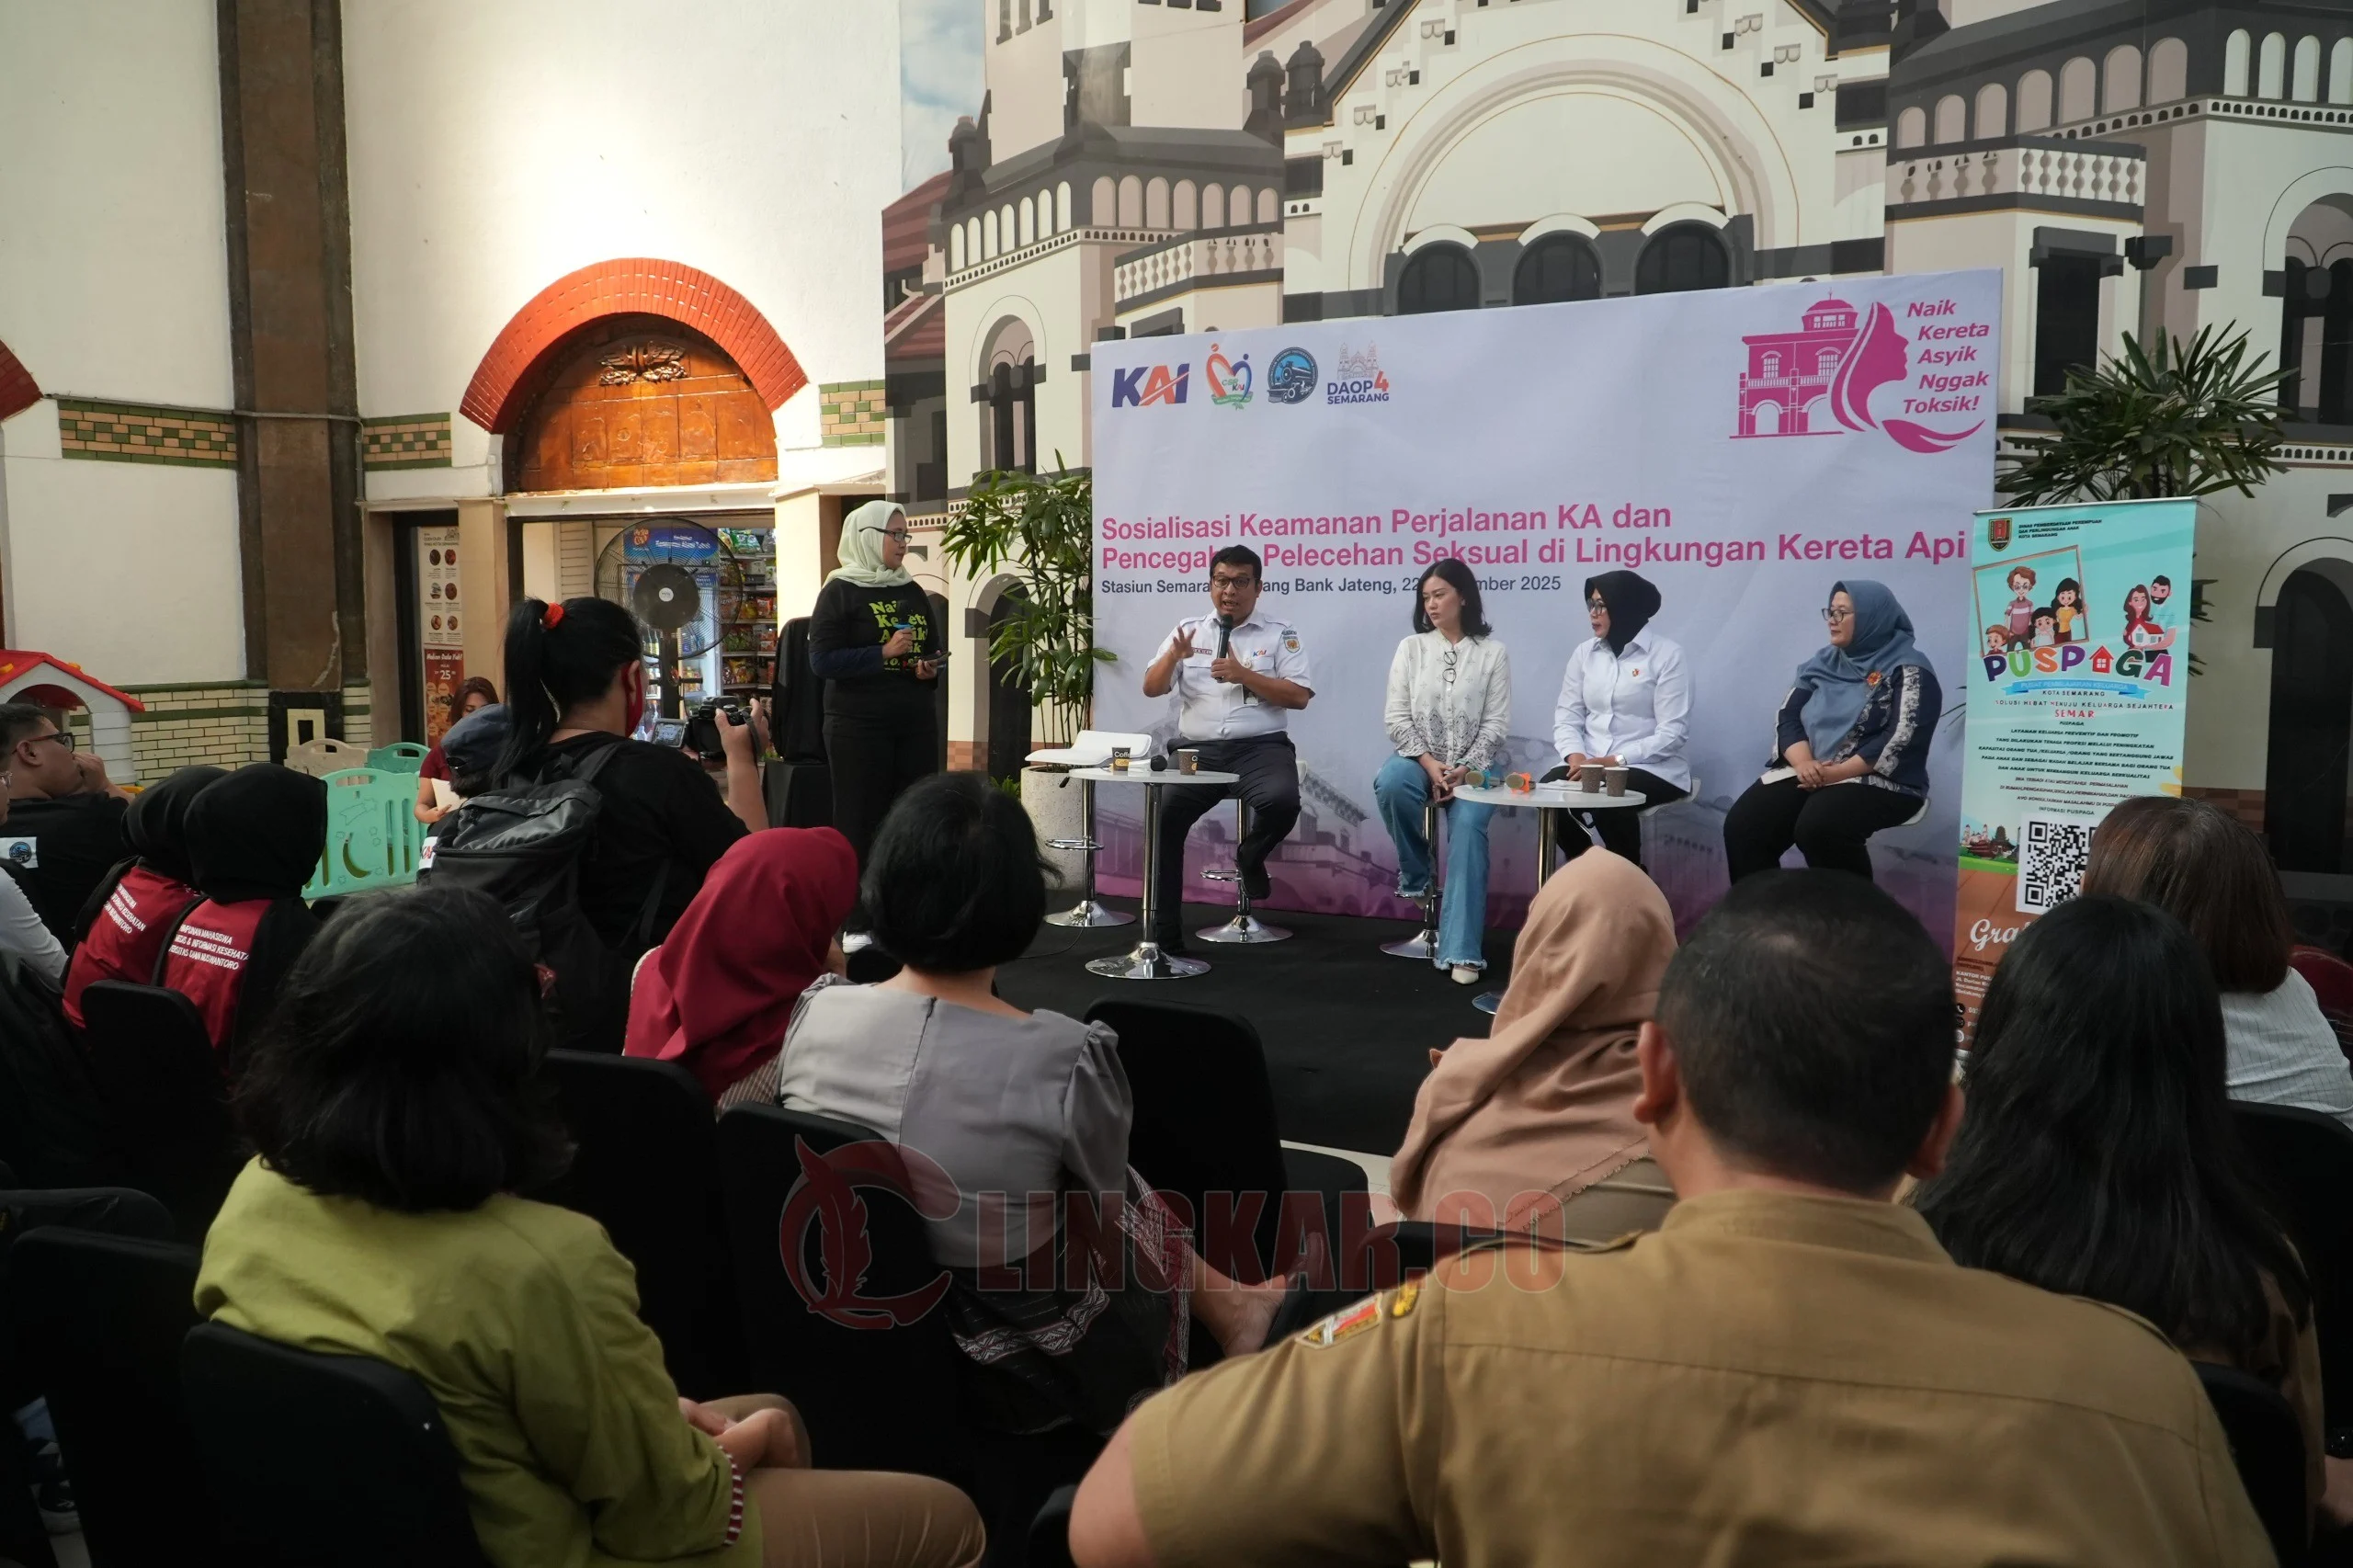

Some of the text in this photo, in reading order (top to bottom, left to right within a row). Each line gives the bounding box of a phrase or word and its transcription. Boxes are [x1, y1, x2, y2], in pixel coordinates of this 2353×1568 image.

[1907, 299, 1957, 318] Naik
[1917, 323, 1990, 341] Kereta
[1917, 346, 1977, 366] Asyik
[1111, 363, 1190, 408] KAI
[1327, 380, 1372, 396] DAOP
[1919, 370, 1989, 392] Nggak
[1327, 392, 1390, 405] SEMARANG
[1904, 395, 1980, 414] Toksik!
[1102, 503, 1671, 540] Sosialisasi Keamanan Perjalanan KA dan
[1264, 542, 1404, 567] Pelecehan
[1413, 539, 1528, 565] Seksual
[1538, 538, 1564, 562] di
[1576, 537, 1766, 568] Lingkungan
[1779, 533, 1893, 561] Kereta
[1904, 530, 1965, 564] Api
[1101, 579, 1153, 594] Stasiun
[1156, 579, 1211, 593] Semara
[1262, 581, 1290, 596] ang
[1295, 577, 1333, 593] Bank
[1338, 578, 1397, 595] Jateng,
[1520, 575, 1562, 591] 2025
[869, 600, 897, 614] Nai
[440, 670, 451, 680] 25
[2054, 709, 2095, 718] SEMAR
